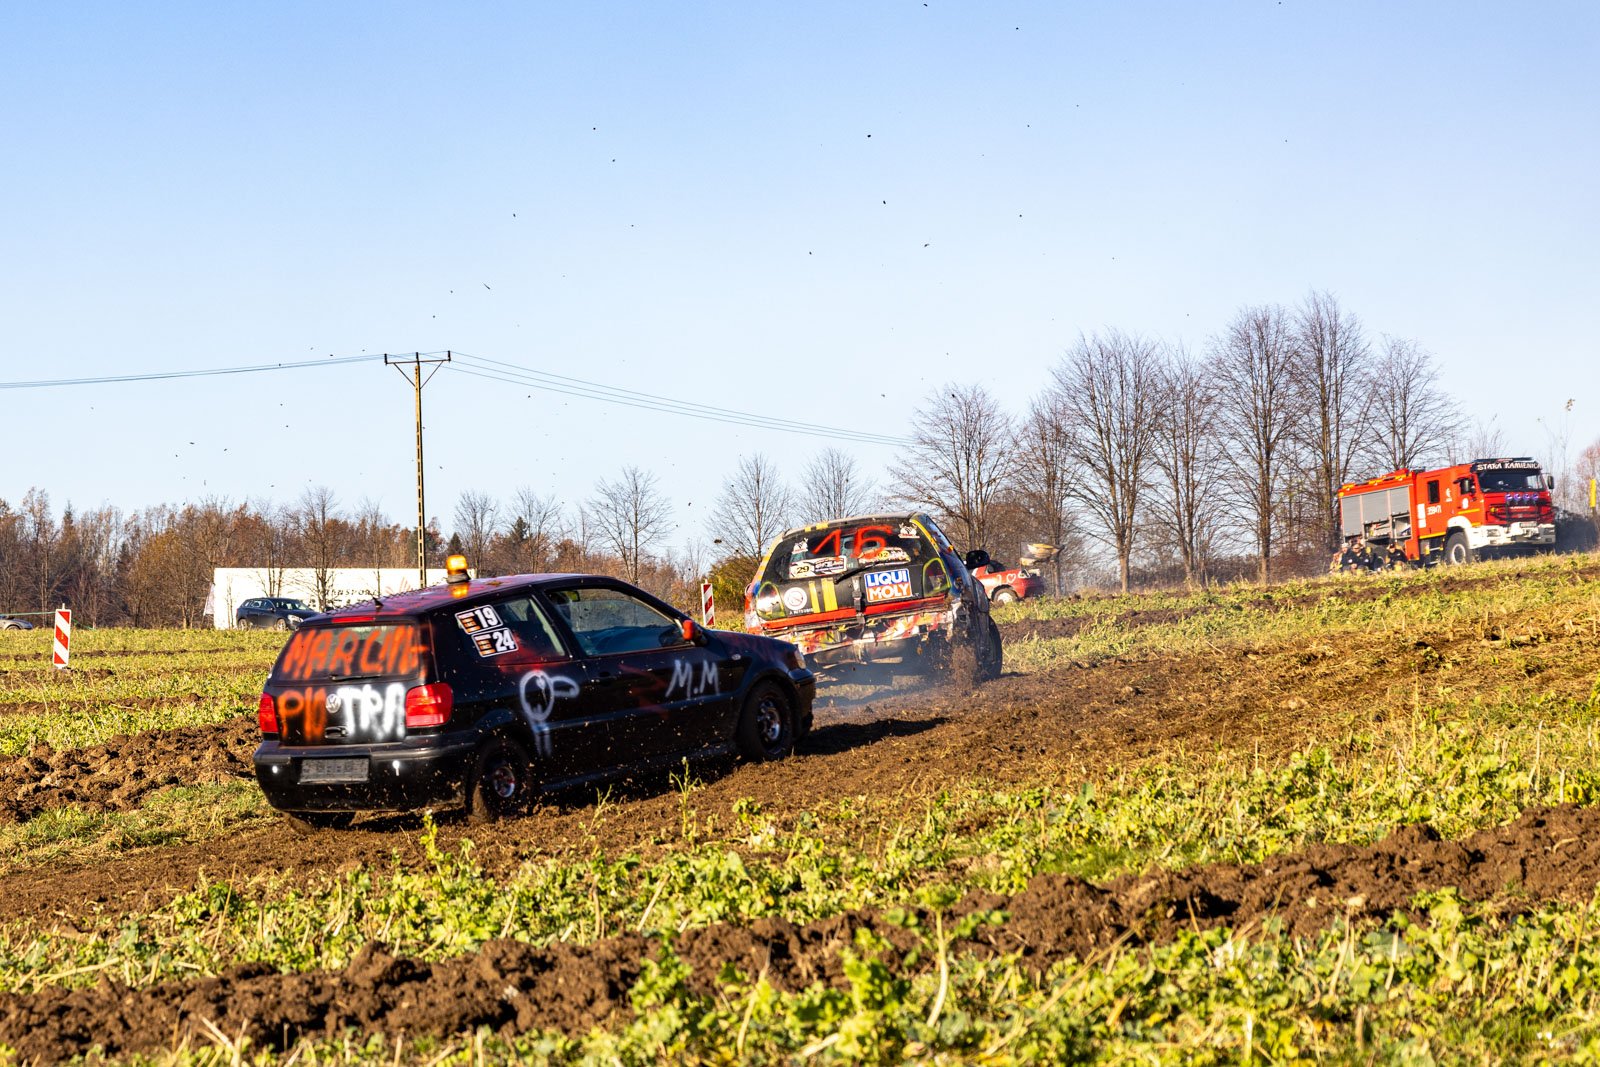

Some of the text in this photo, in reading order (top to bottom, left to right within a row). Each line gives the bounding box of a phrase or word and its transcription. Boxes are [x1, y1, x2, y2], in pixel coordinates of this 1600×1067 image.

[796, 565, 810, 574] 29
[866, 571, 909, 587] LIQUI
[868, 584, 911, 601] MOLY
[474, 607, 499, 629] 19
[492, 629, 515, 652] 24
